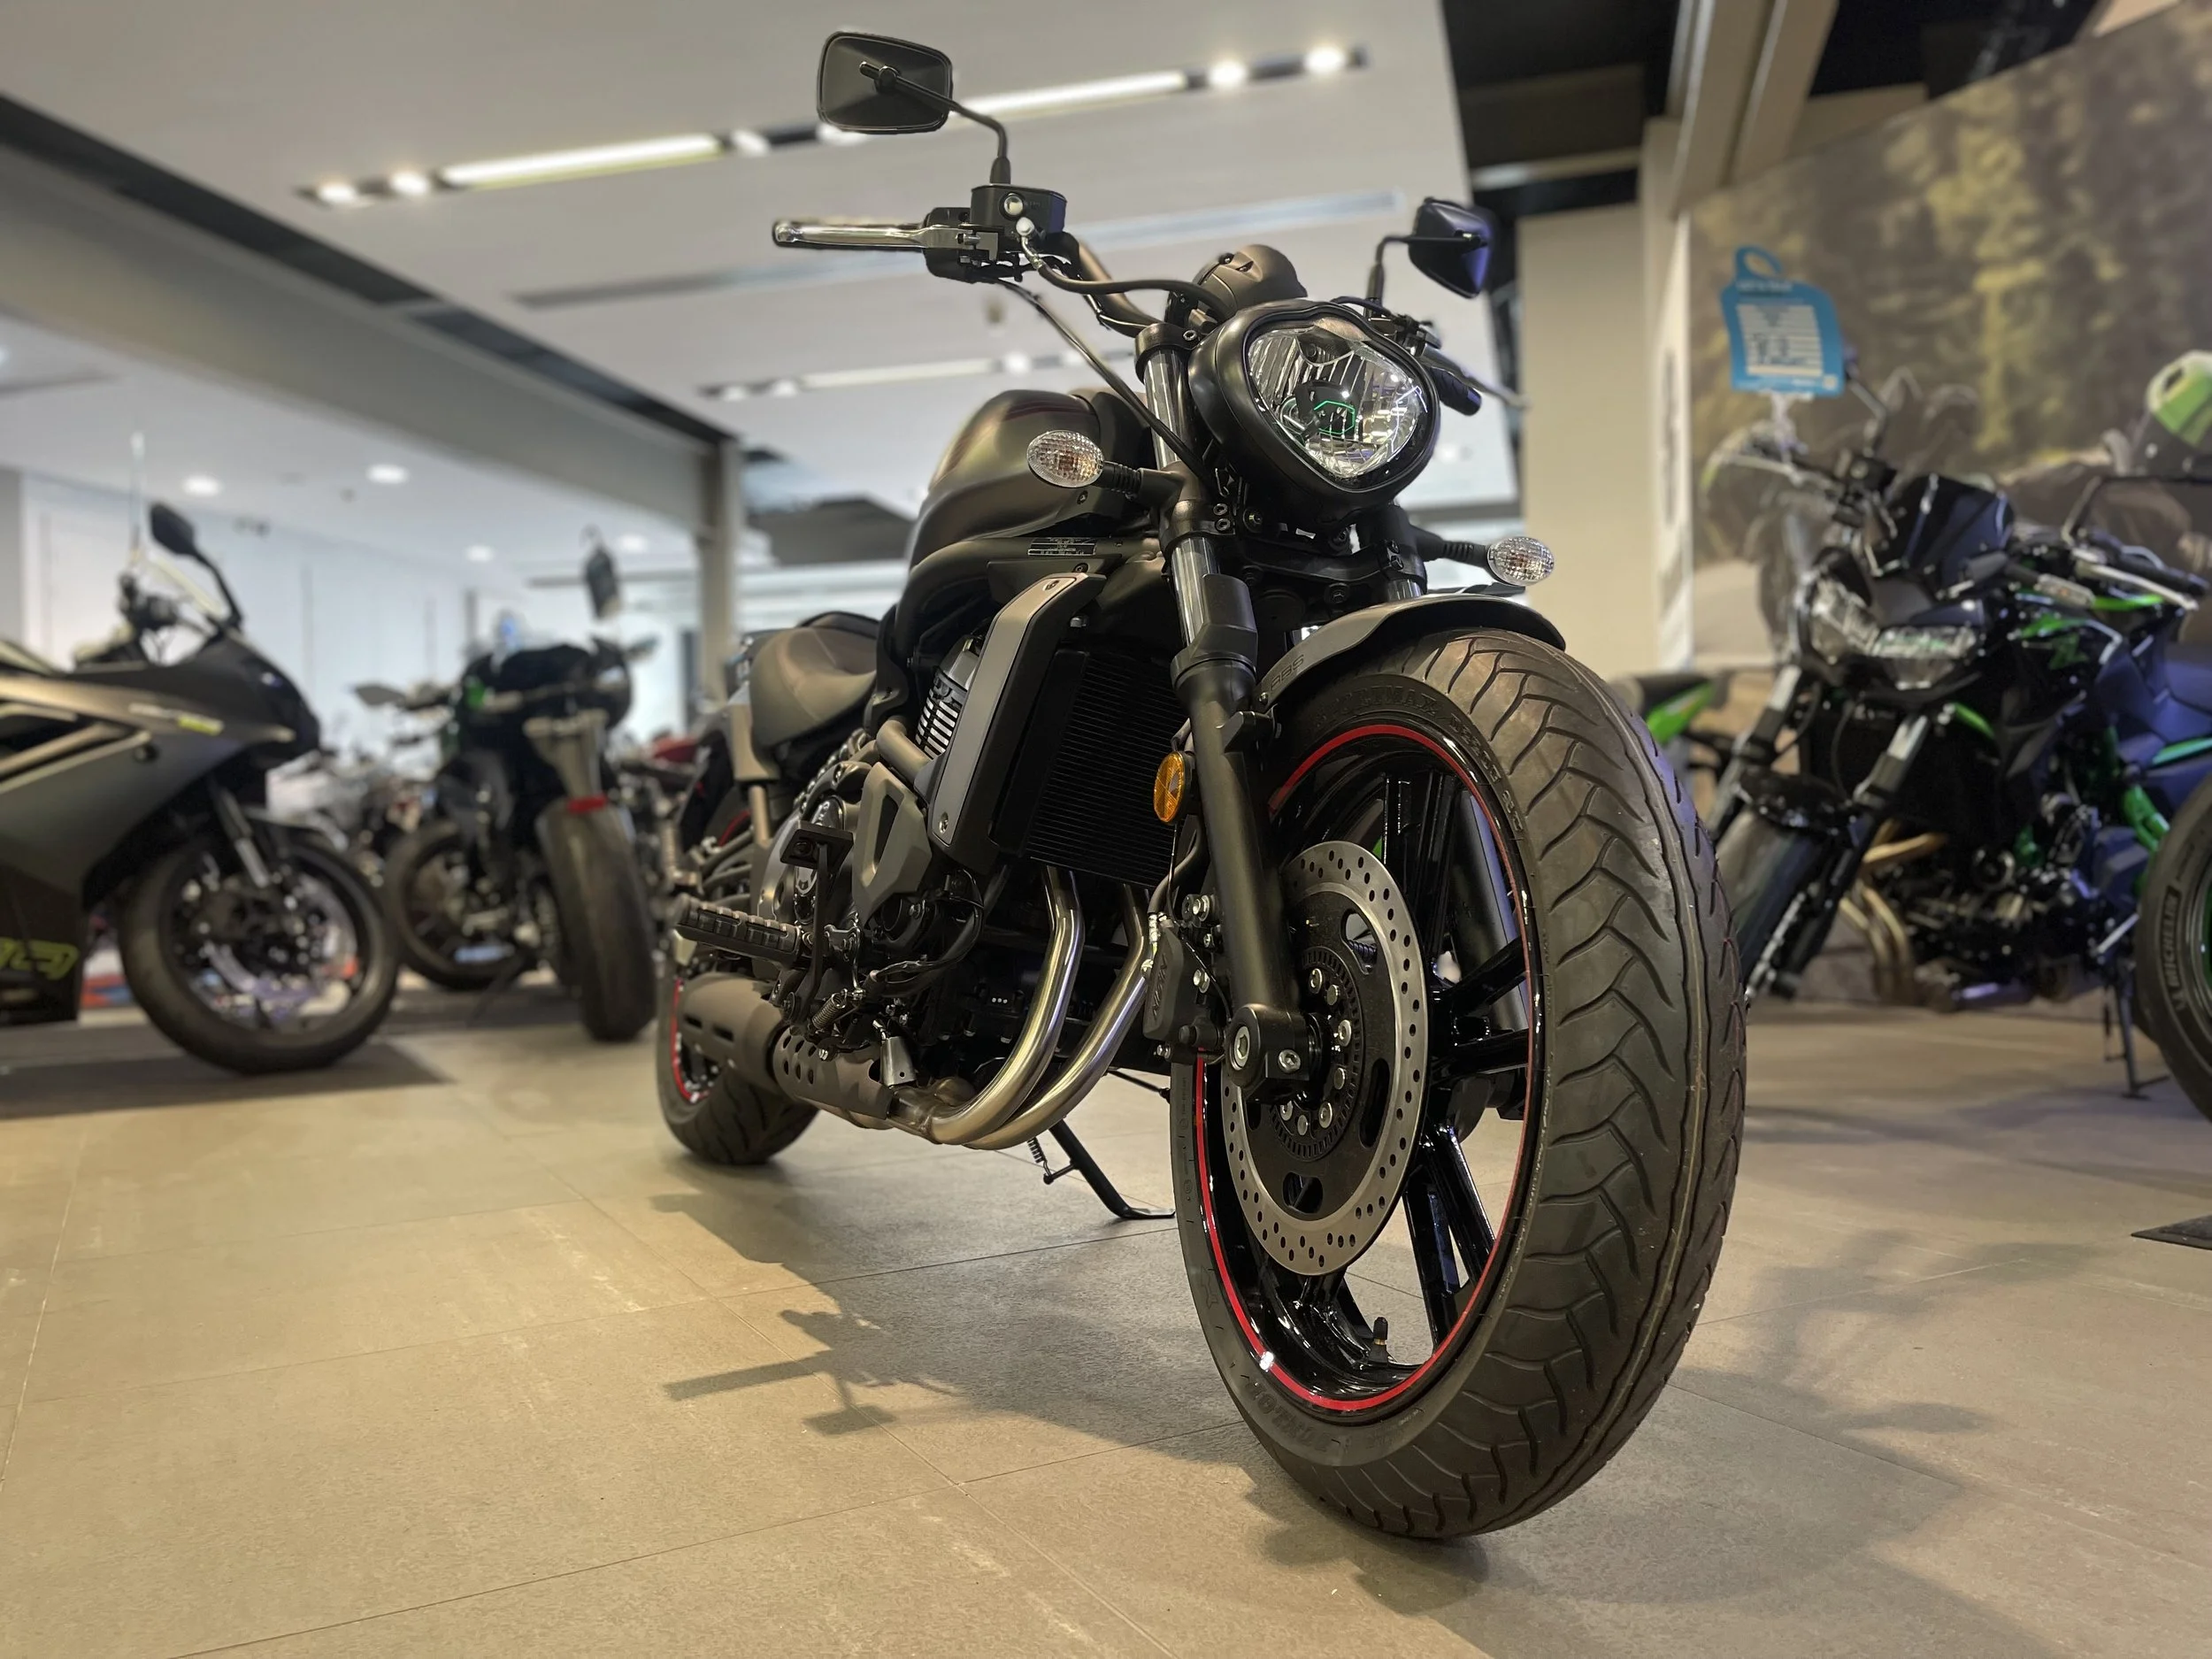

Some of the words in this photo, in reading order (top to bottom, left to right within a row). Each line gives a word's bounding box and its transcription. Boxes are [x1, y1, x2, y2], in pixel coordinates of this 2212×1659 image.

[1270, 652, 1306, 692] ABS
[2163, 894, 2182, 987] MICHELIN
[1151, 952, 1168, 1020] NISSIN
